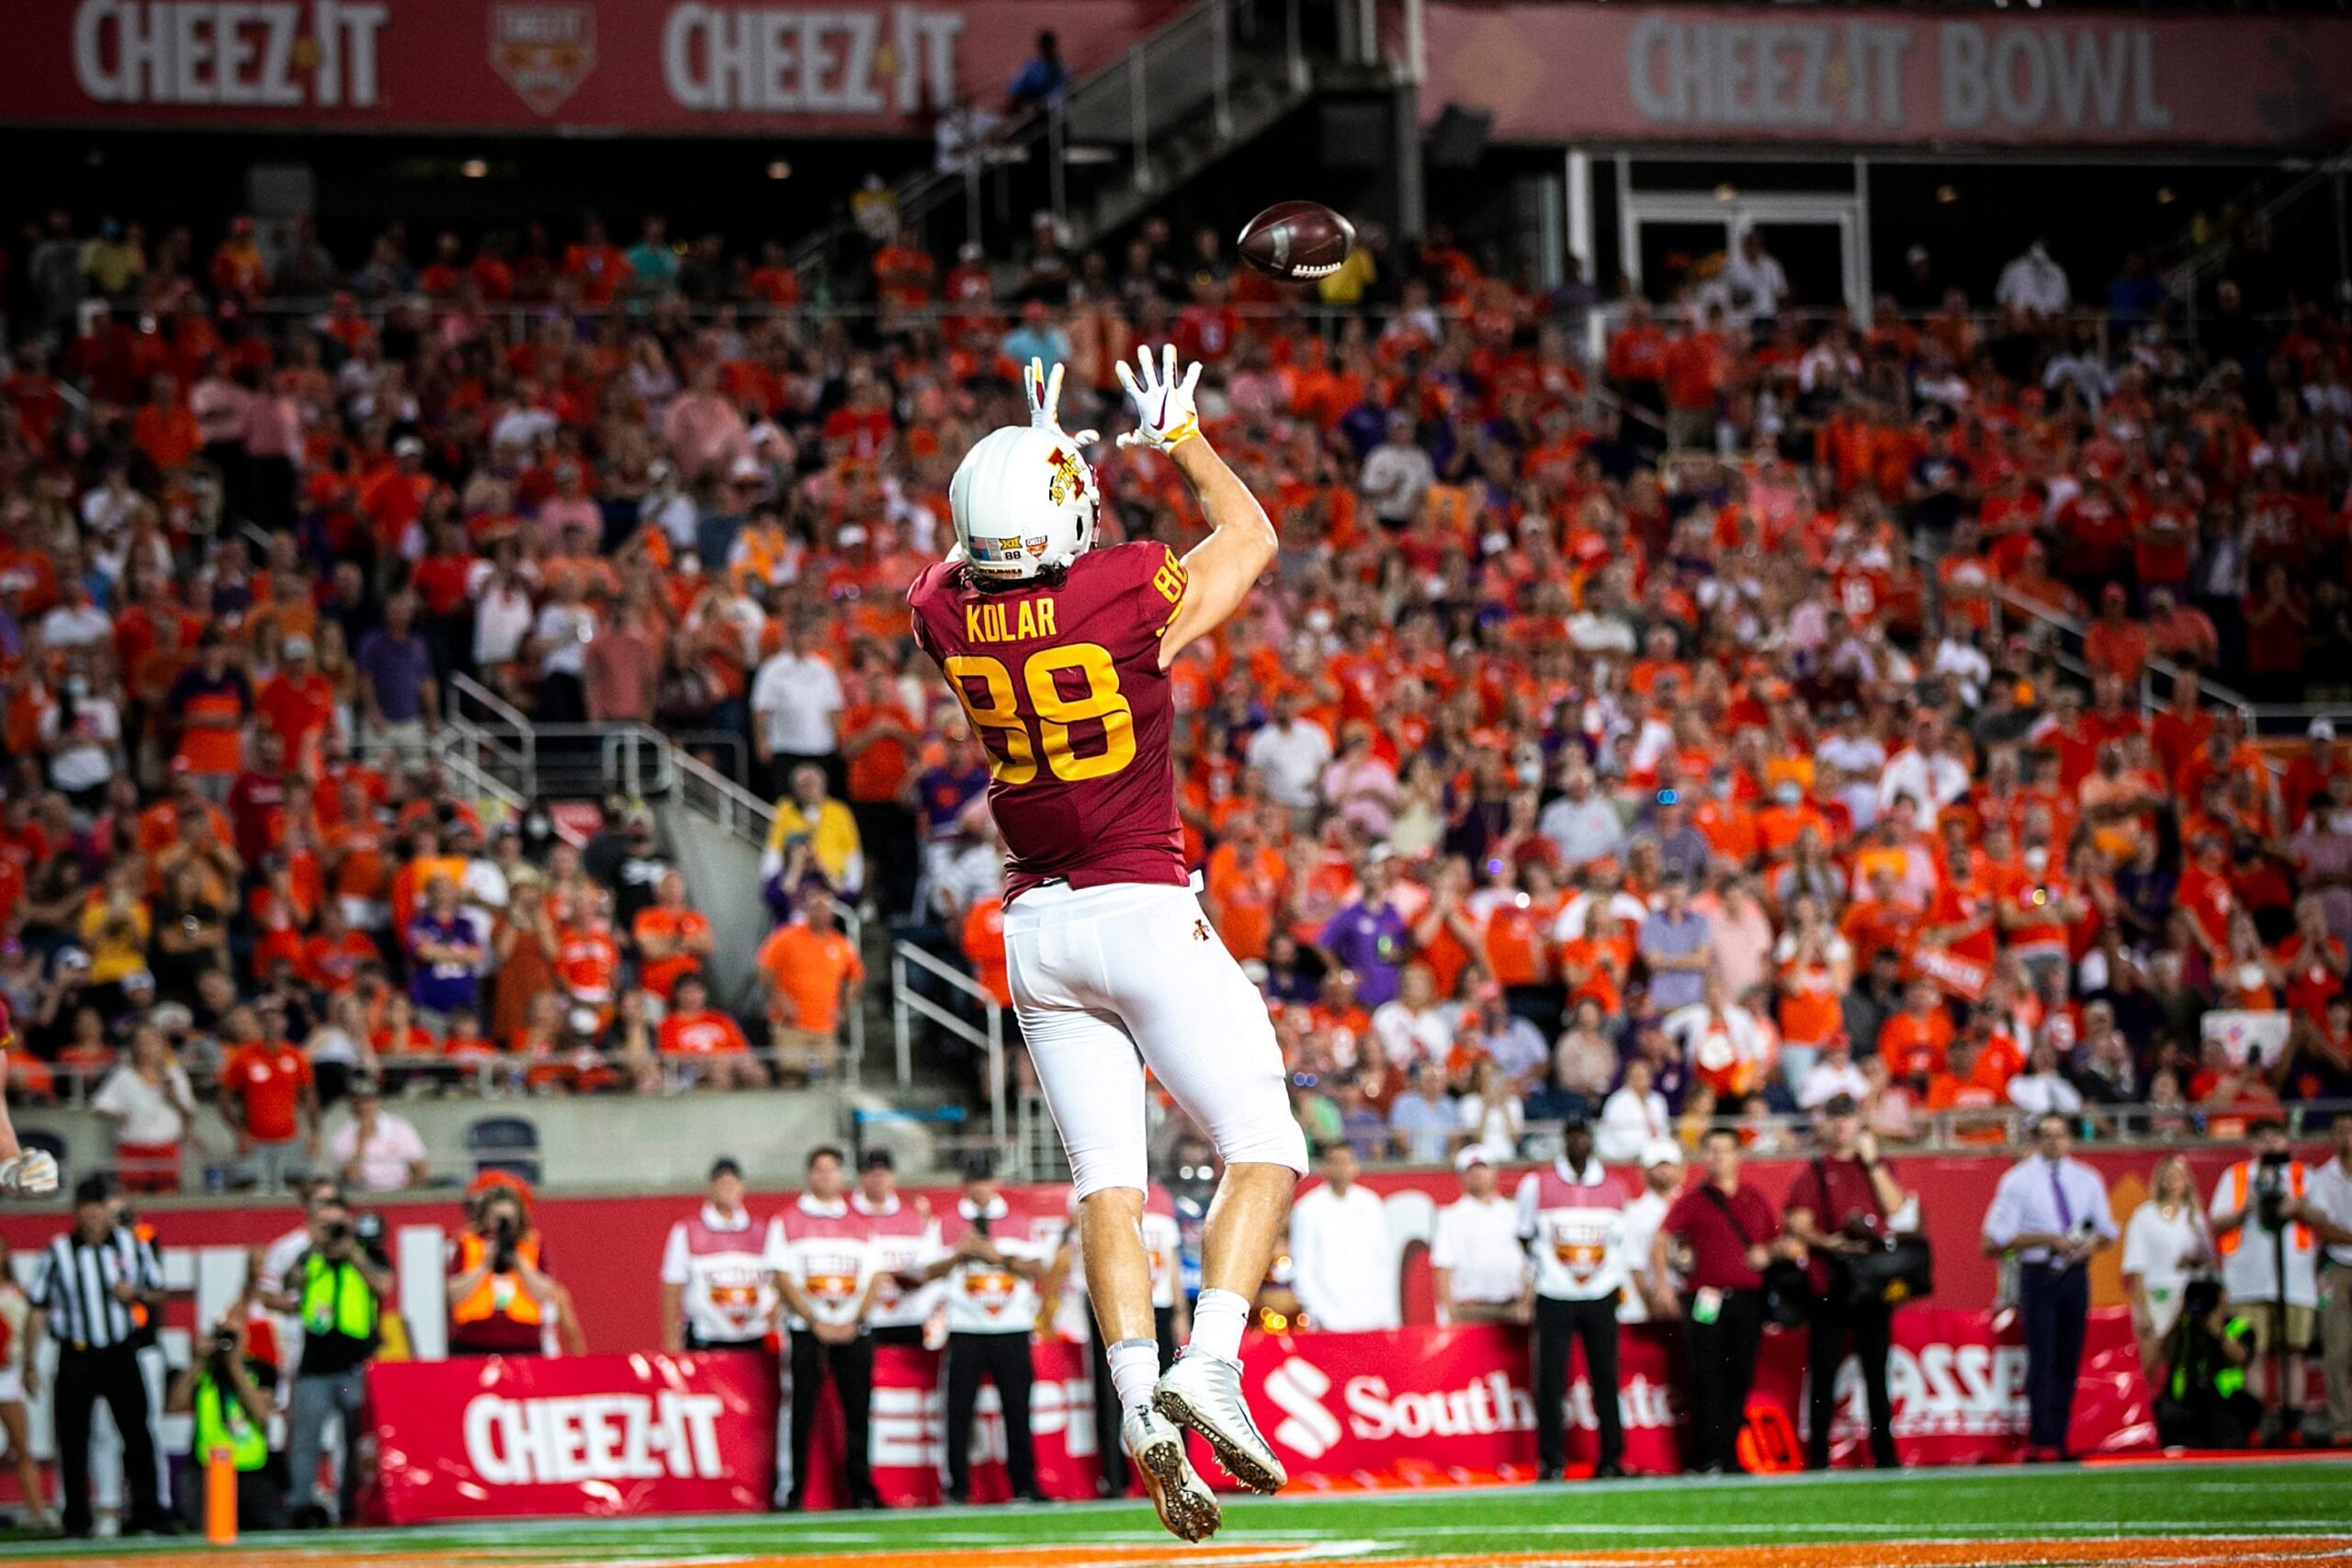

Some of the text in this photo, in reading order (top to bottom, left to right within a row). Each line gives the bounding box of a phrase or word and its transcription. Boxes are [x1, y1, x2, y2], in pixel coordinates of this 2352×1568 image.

[1940, 20, 2175, 130] BOWL
[1005, 551, 1021, 560] 88
[966, 597, 1057, 643] KOLAR
[944, 642, 1137, 785] 88
